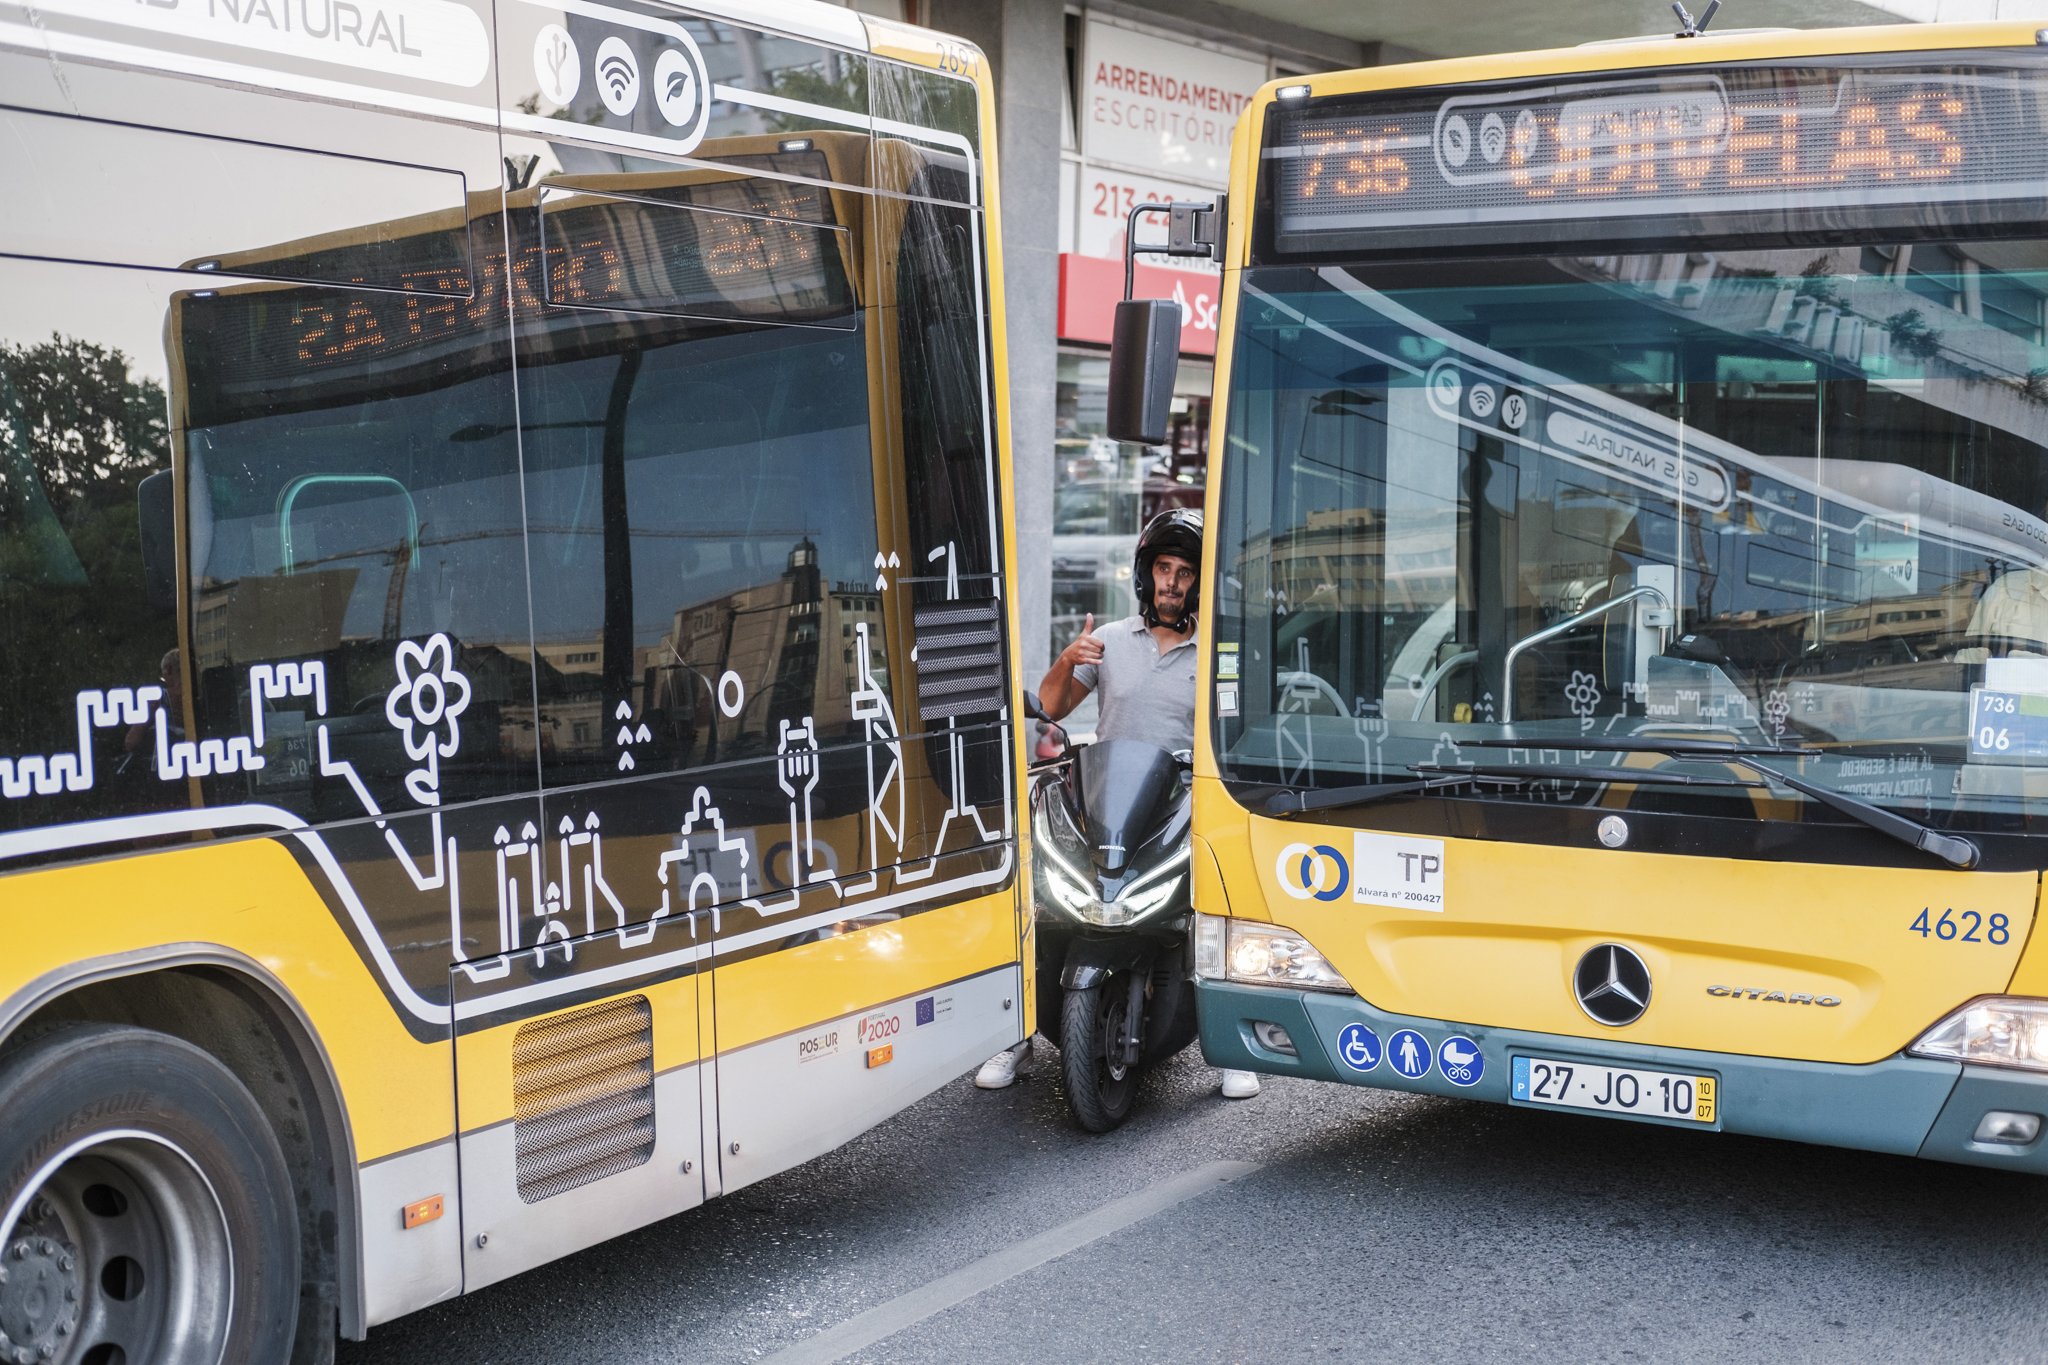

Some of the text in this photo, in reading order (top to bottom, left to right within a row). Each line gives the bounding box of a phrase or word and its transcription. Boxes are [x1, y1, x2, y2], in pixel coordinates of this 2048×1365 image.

[936, 42, 978, 78] 2691
[1510, 91, 1965, 199] ODIVELAS
[1983, 696, 2015, 714] 736
[1979, 726, 2010, 750] 06
[1098, 844, 1127, 852] HONDA
[1397, 852, 1440, 884] TP
[1357, 887, 1389, 898] Alvará
[1404, 892, 1442, 904] 200427
[1908, 907, 2010, 946] 4628
[1706, 984, 1842, 1008] CITARO
[868, 1016, 900, 1042] 2020
[1517, 1082, 1525, 1093] P
[1699, 1082, 1710, 1096] 10
[1698, 1105, 1712, 1118] 07
